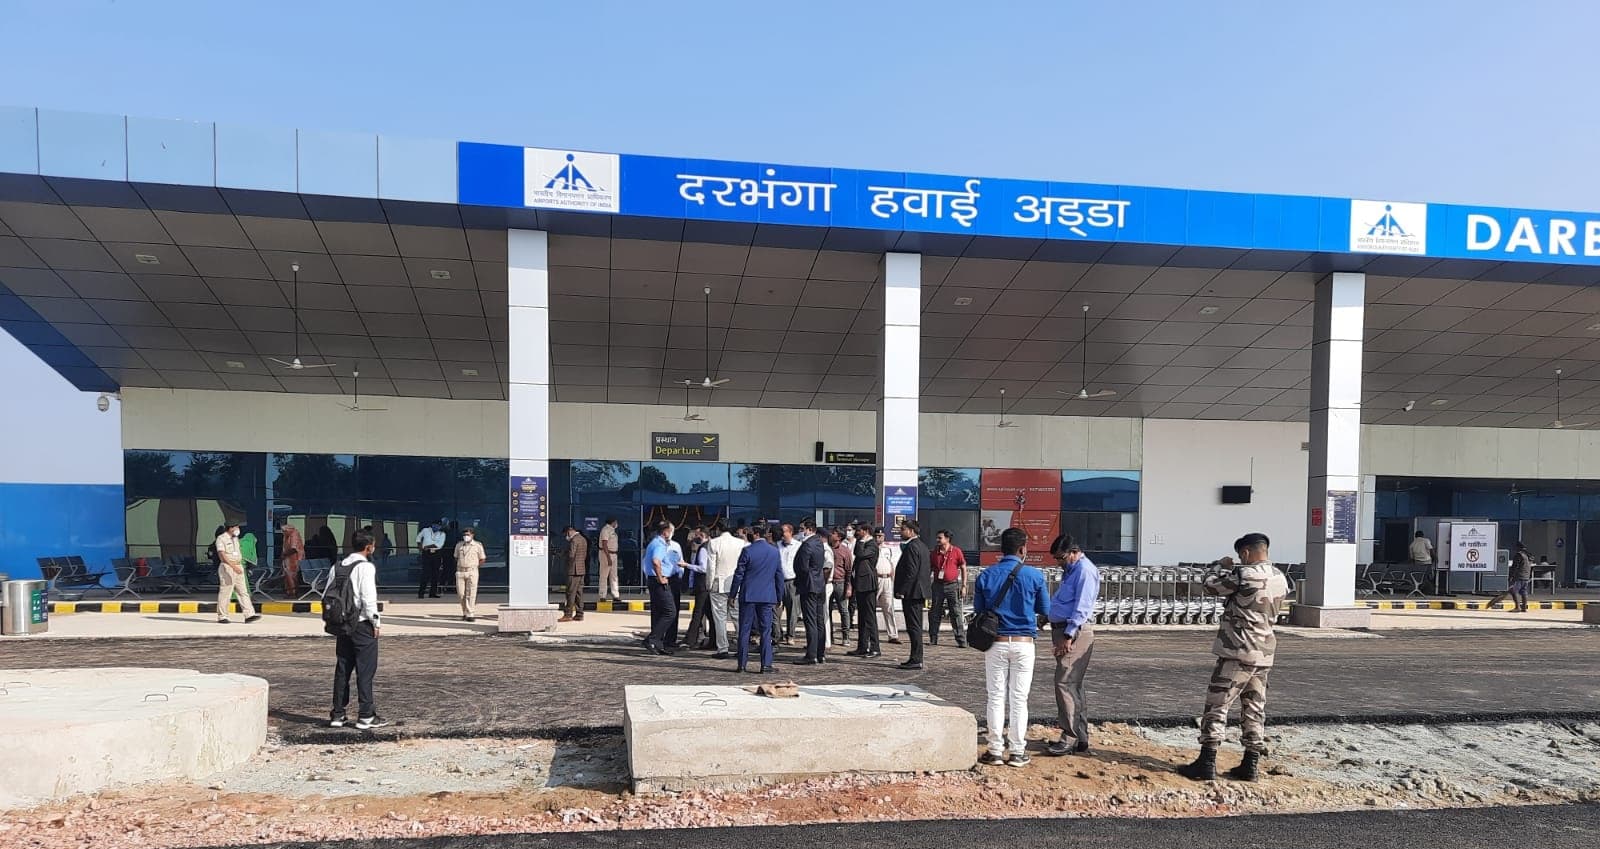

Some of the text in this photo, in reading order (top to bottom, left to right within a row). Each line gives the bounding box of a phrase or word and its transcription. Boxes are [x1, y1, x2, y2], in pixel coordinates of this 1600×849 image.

[676, 168, 1131, 237] दरभंगा हवाई अड्डा
[655, 436, 677, 444] प्रस्थान
[655, 446, 701, 457] Departure
